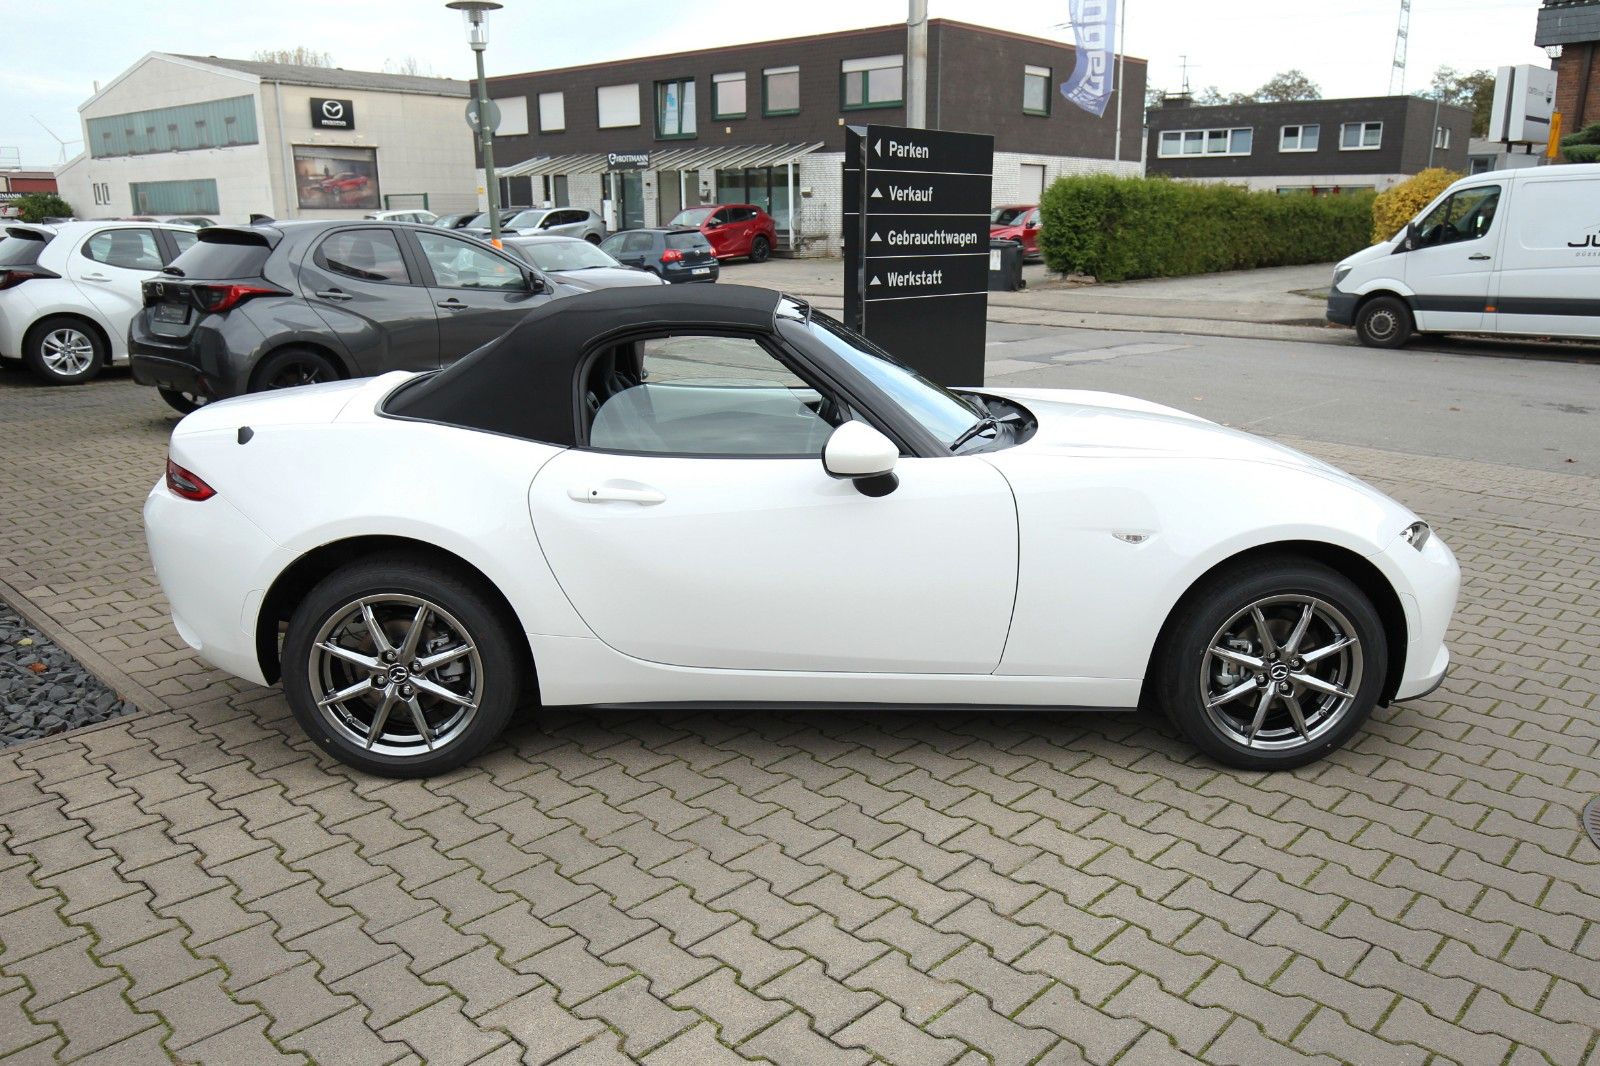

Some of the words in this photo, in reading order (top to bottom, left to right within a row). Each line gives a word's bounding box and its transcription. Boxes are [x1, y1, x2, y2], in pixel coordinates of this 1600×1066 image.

[888, 140, 929, 159] Parken
[888, 185, 934, 202] Verkauf
[887, 229, 978, 247] Gebrauchtwagen
[887, 269, 943, 287] Werkstatt
